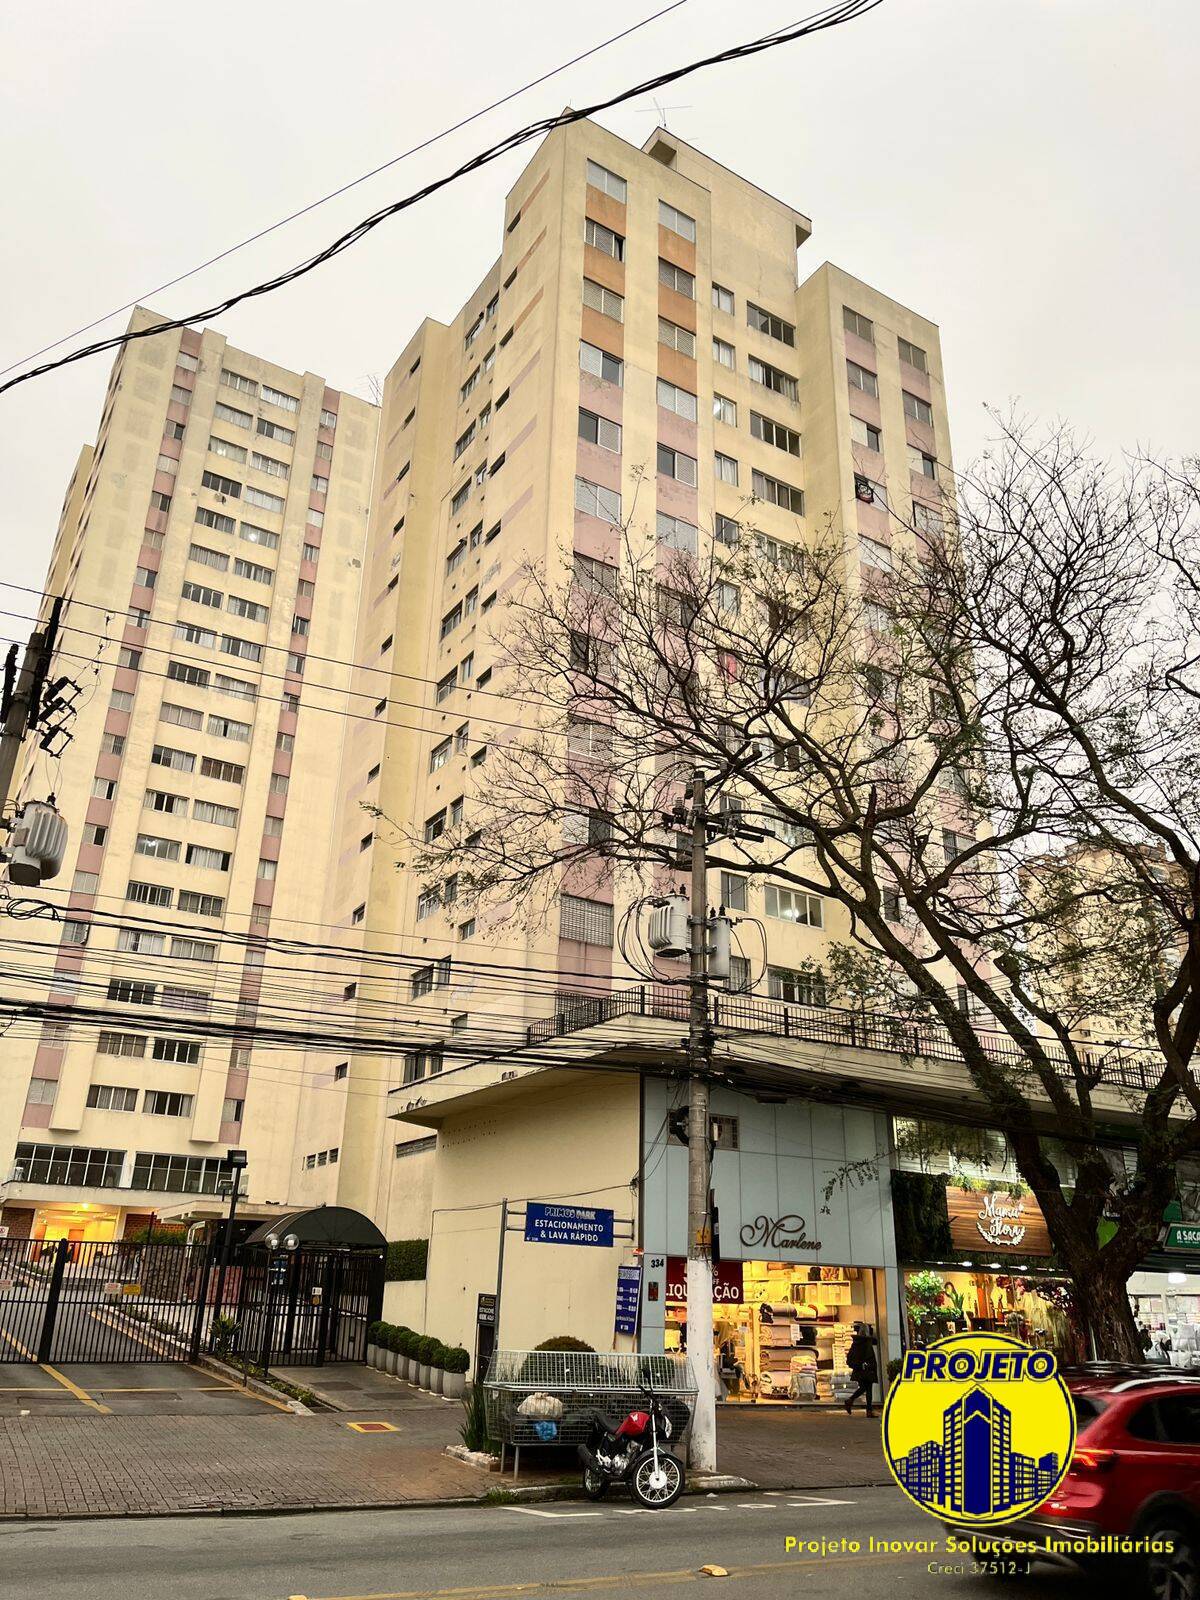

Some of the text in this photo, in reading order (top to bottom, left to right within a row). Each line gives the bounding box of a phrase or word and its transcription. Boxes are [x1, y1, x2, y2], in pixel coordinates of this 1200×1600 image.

[576, 1209, 596, 1220] PARK
[534, 1219, 604, 1232] ESTACIONAMENTO
[740, 1214, 822, 1250] Marlene
[540, 1229, 546, 1238] &
[548, 1230, 568, 1240] LAVA
[570, 1230, 599, 1242] RÁPIDO
[650, 1258, 665, 1268] 334
